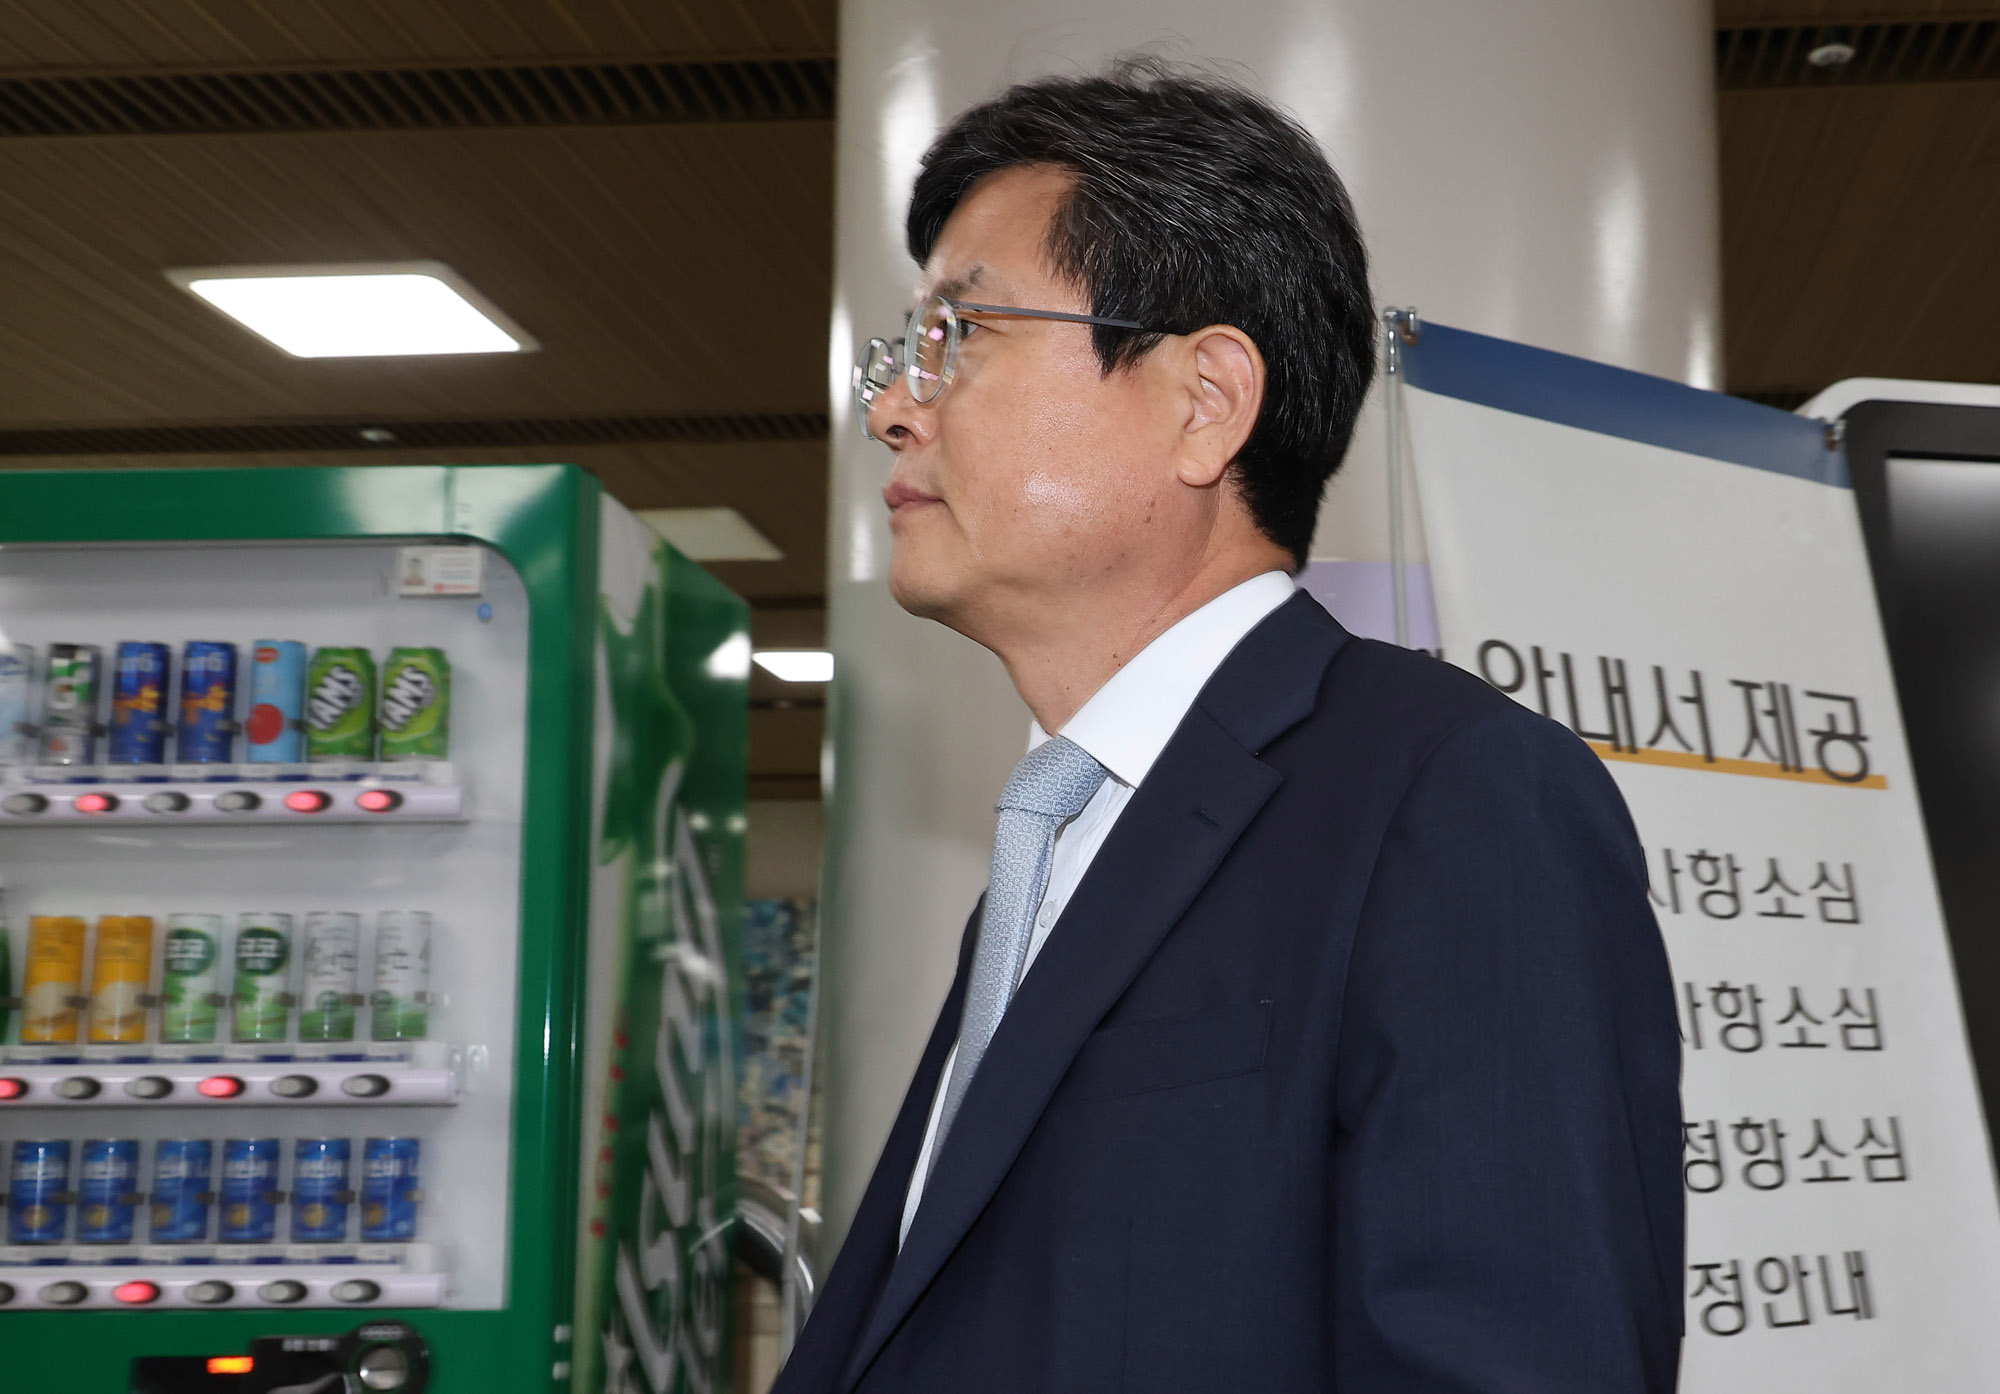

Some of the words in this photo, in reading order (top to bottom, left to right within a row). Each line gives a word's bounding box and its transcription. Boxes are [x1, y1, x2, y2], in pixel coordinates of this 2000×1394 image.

[1729, 677, 1872, 783] 제공
[1682, 1116, 1912, 1194] 정항소심
[1687, 1249, 1877, 1337] 정안내
